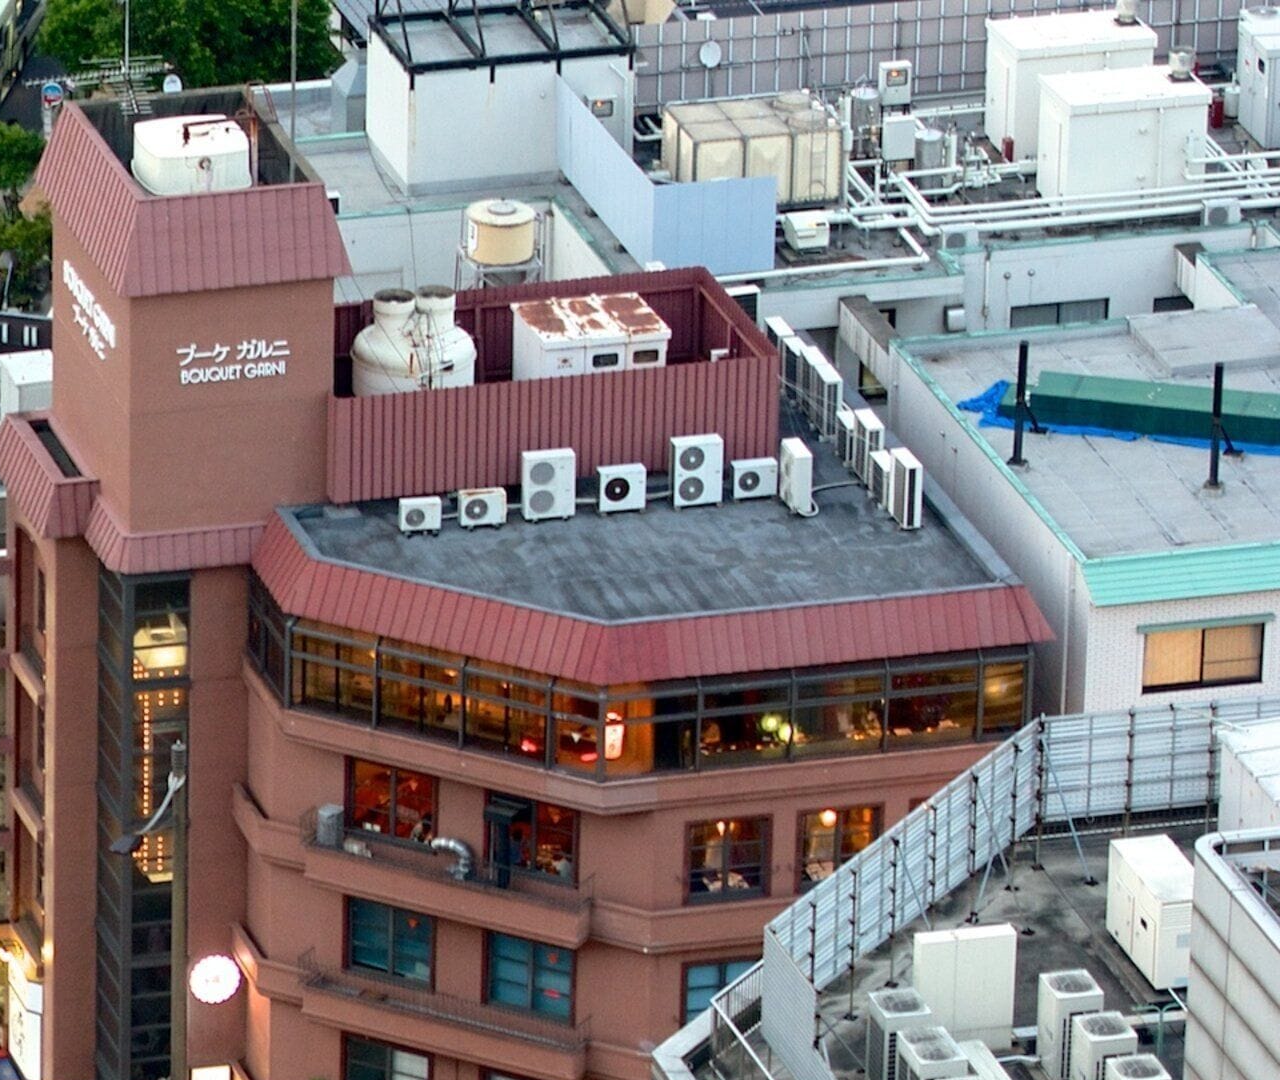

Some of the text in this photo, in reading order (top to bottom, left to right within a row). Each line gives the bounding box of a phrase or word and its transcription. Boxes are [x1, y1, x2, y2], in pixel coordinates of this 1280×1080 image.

[176, 339, 291, 367] ブーケ ガルニ
[180, 361, 287, 385] BOUQUET GARNI
